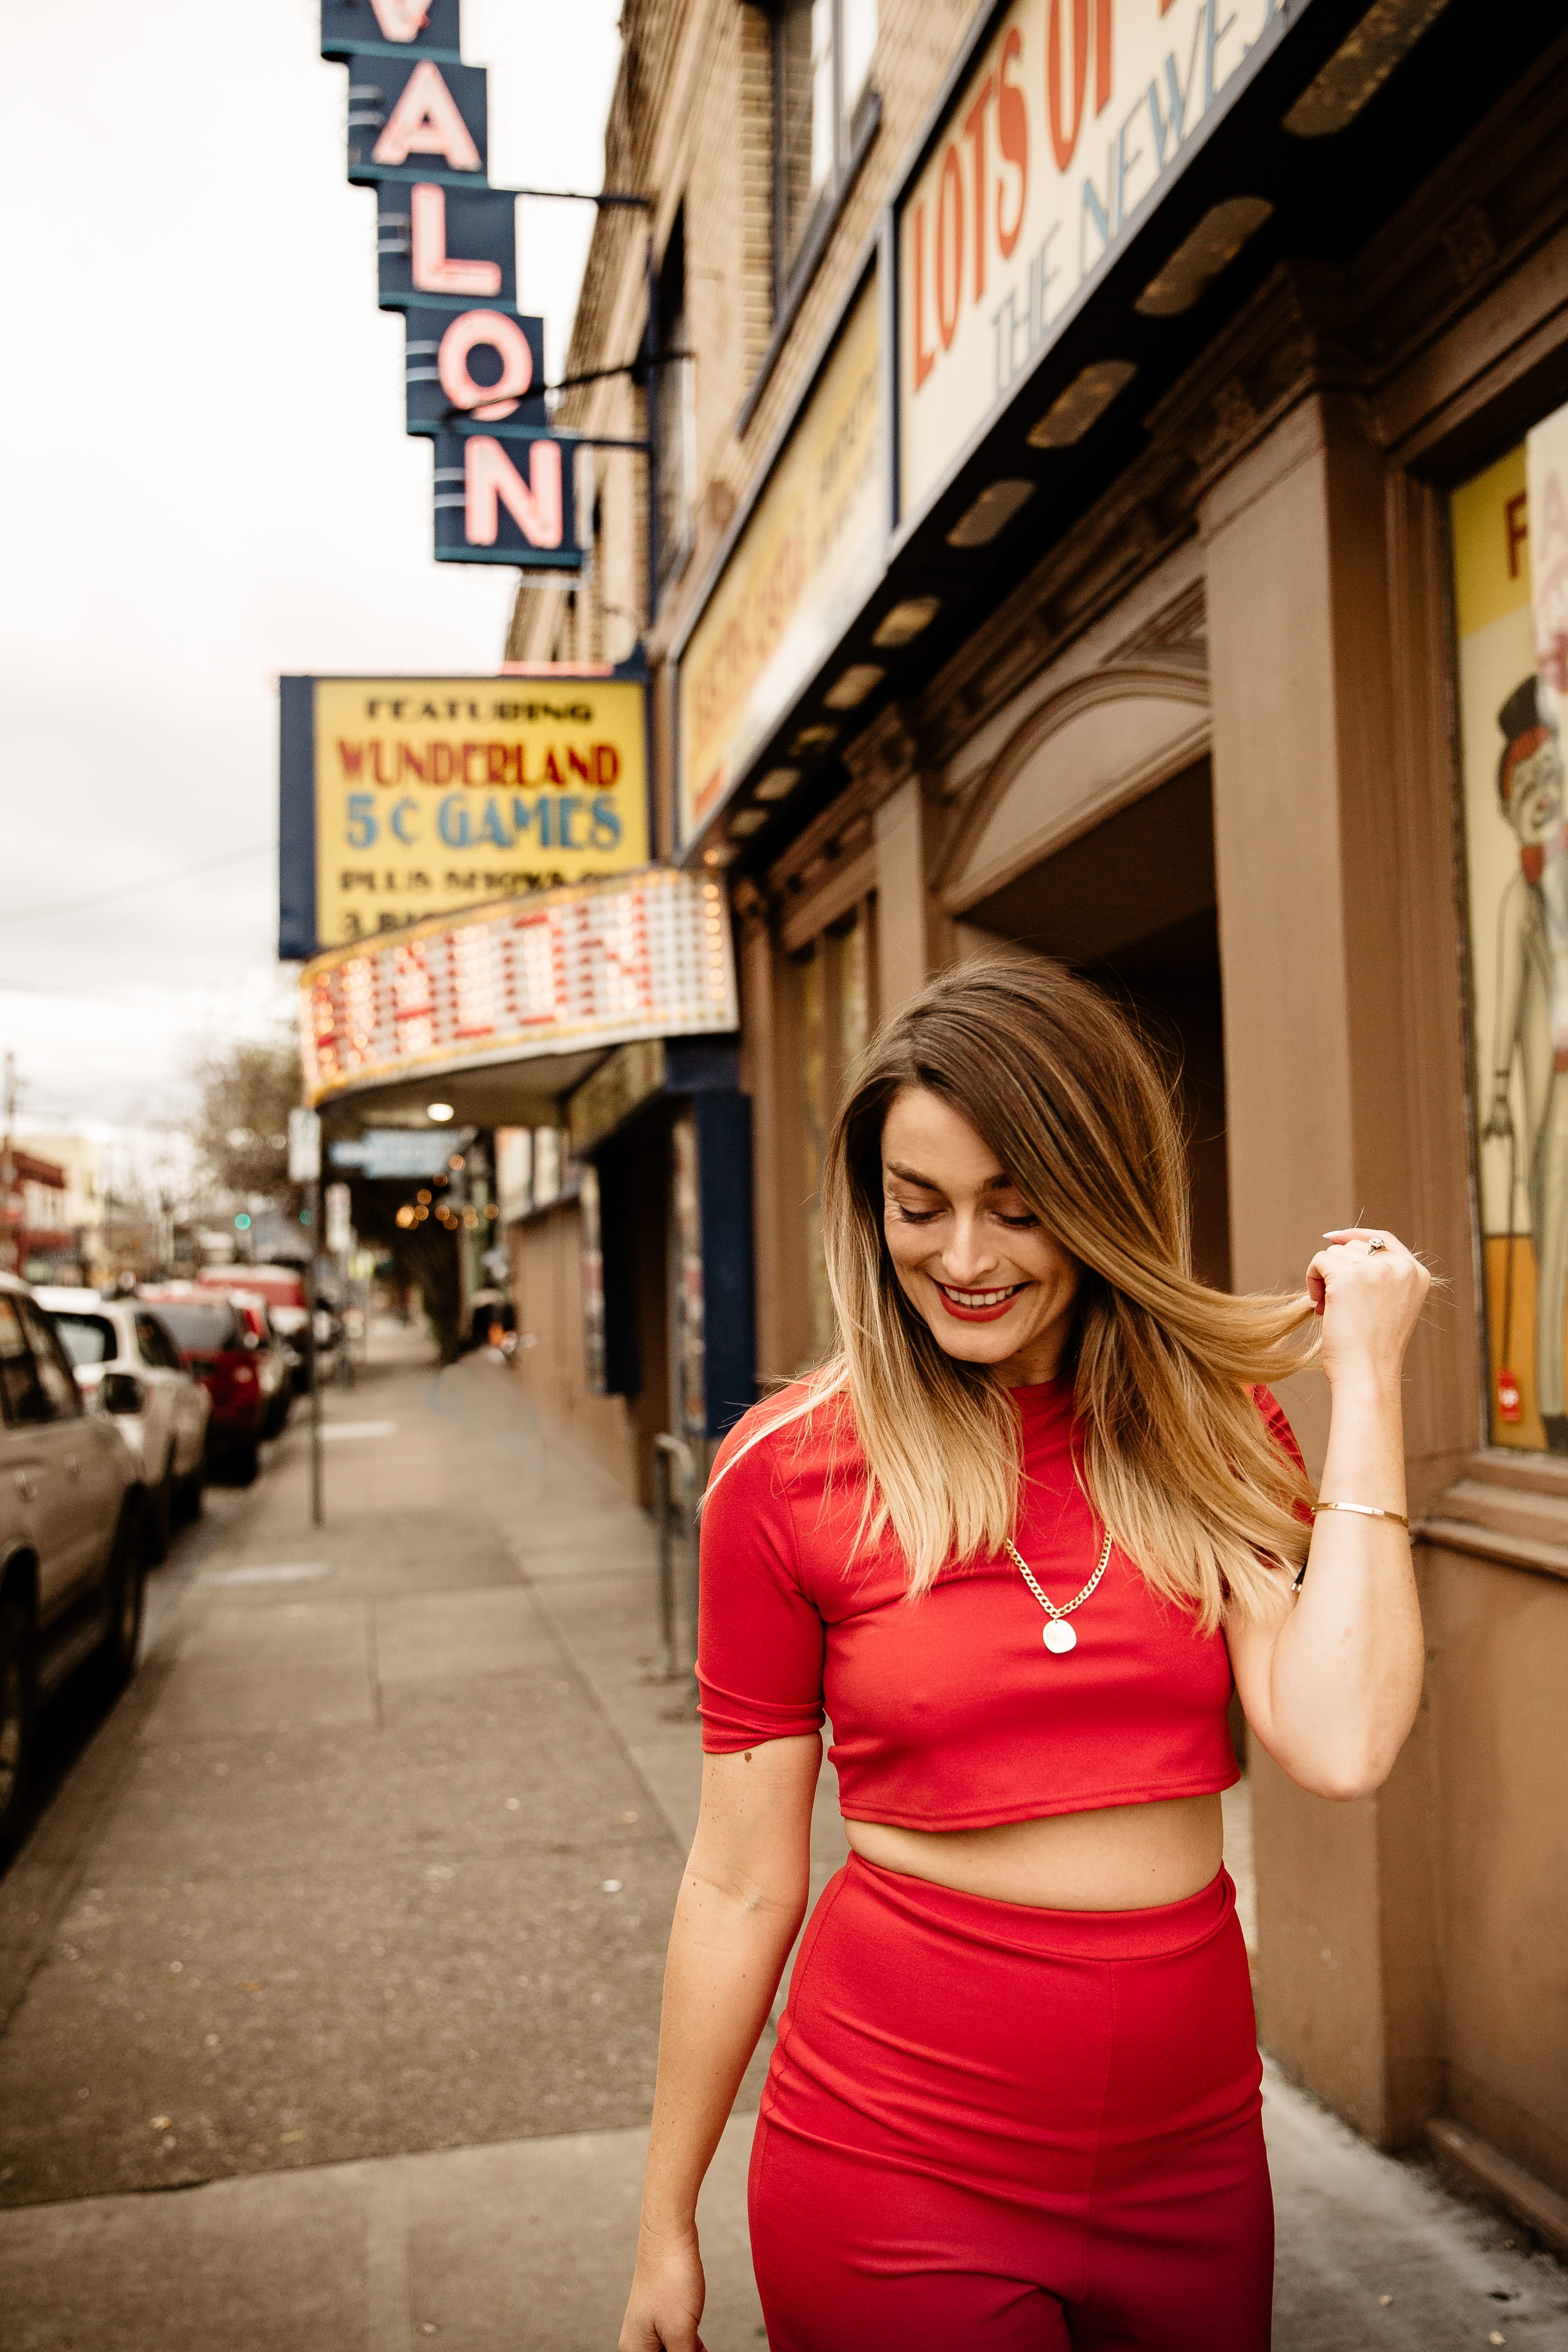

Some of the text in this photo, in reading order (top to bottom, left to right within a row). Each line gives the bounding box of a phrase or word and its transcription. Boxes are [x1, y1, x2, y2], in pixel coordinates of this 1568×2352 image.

[913, 26, 1029, 395] LOTS
[992, 220, 1062, 403] THE
[366, 696, 595, 724] FEATURING
[337, 738, 621, 788] WUNDERLAND
[436, 791, 623, 852] GAMES
